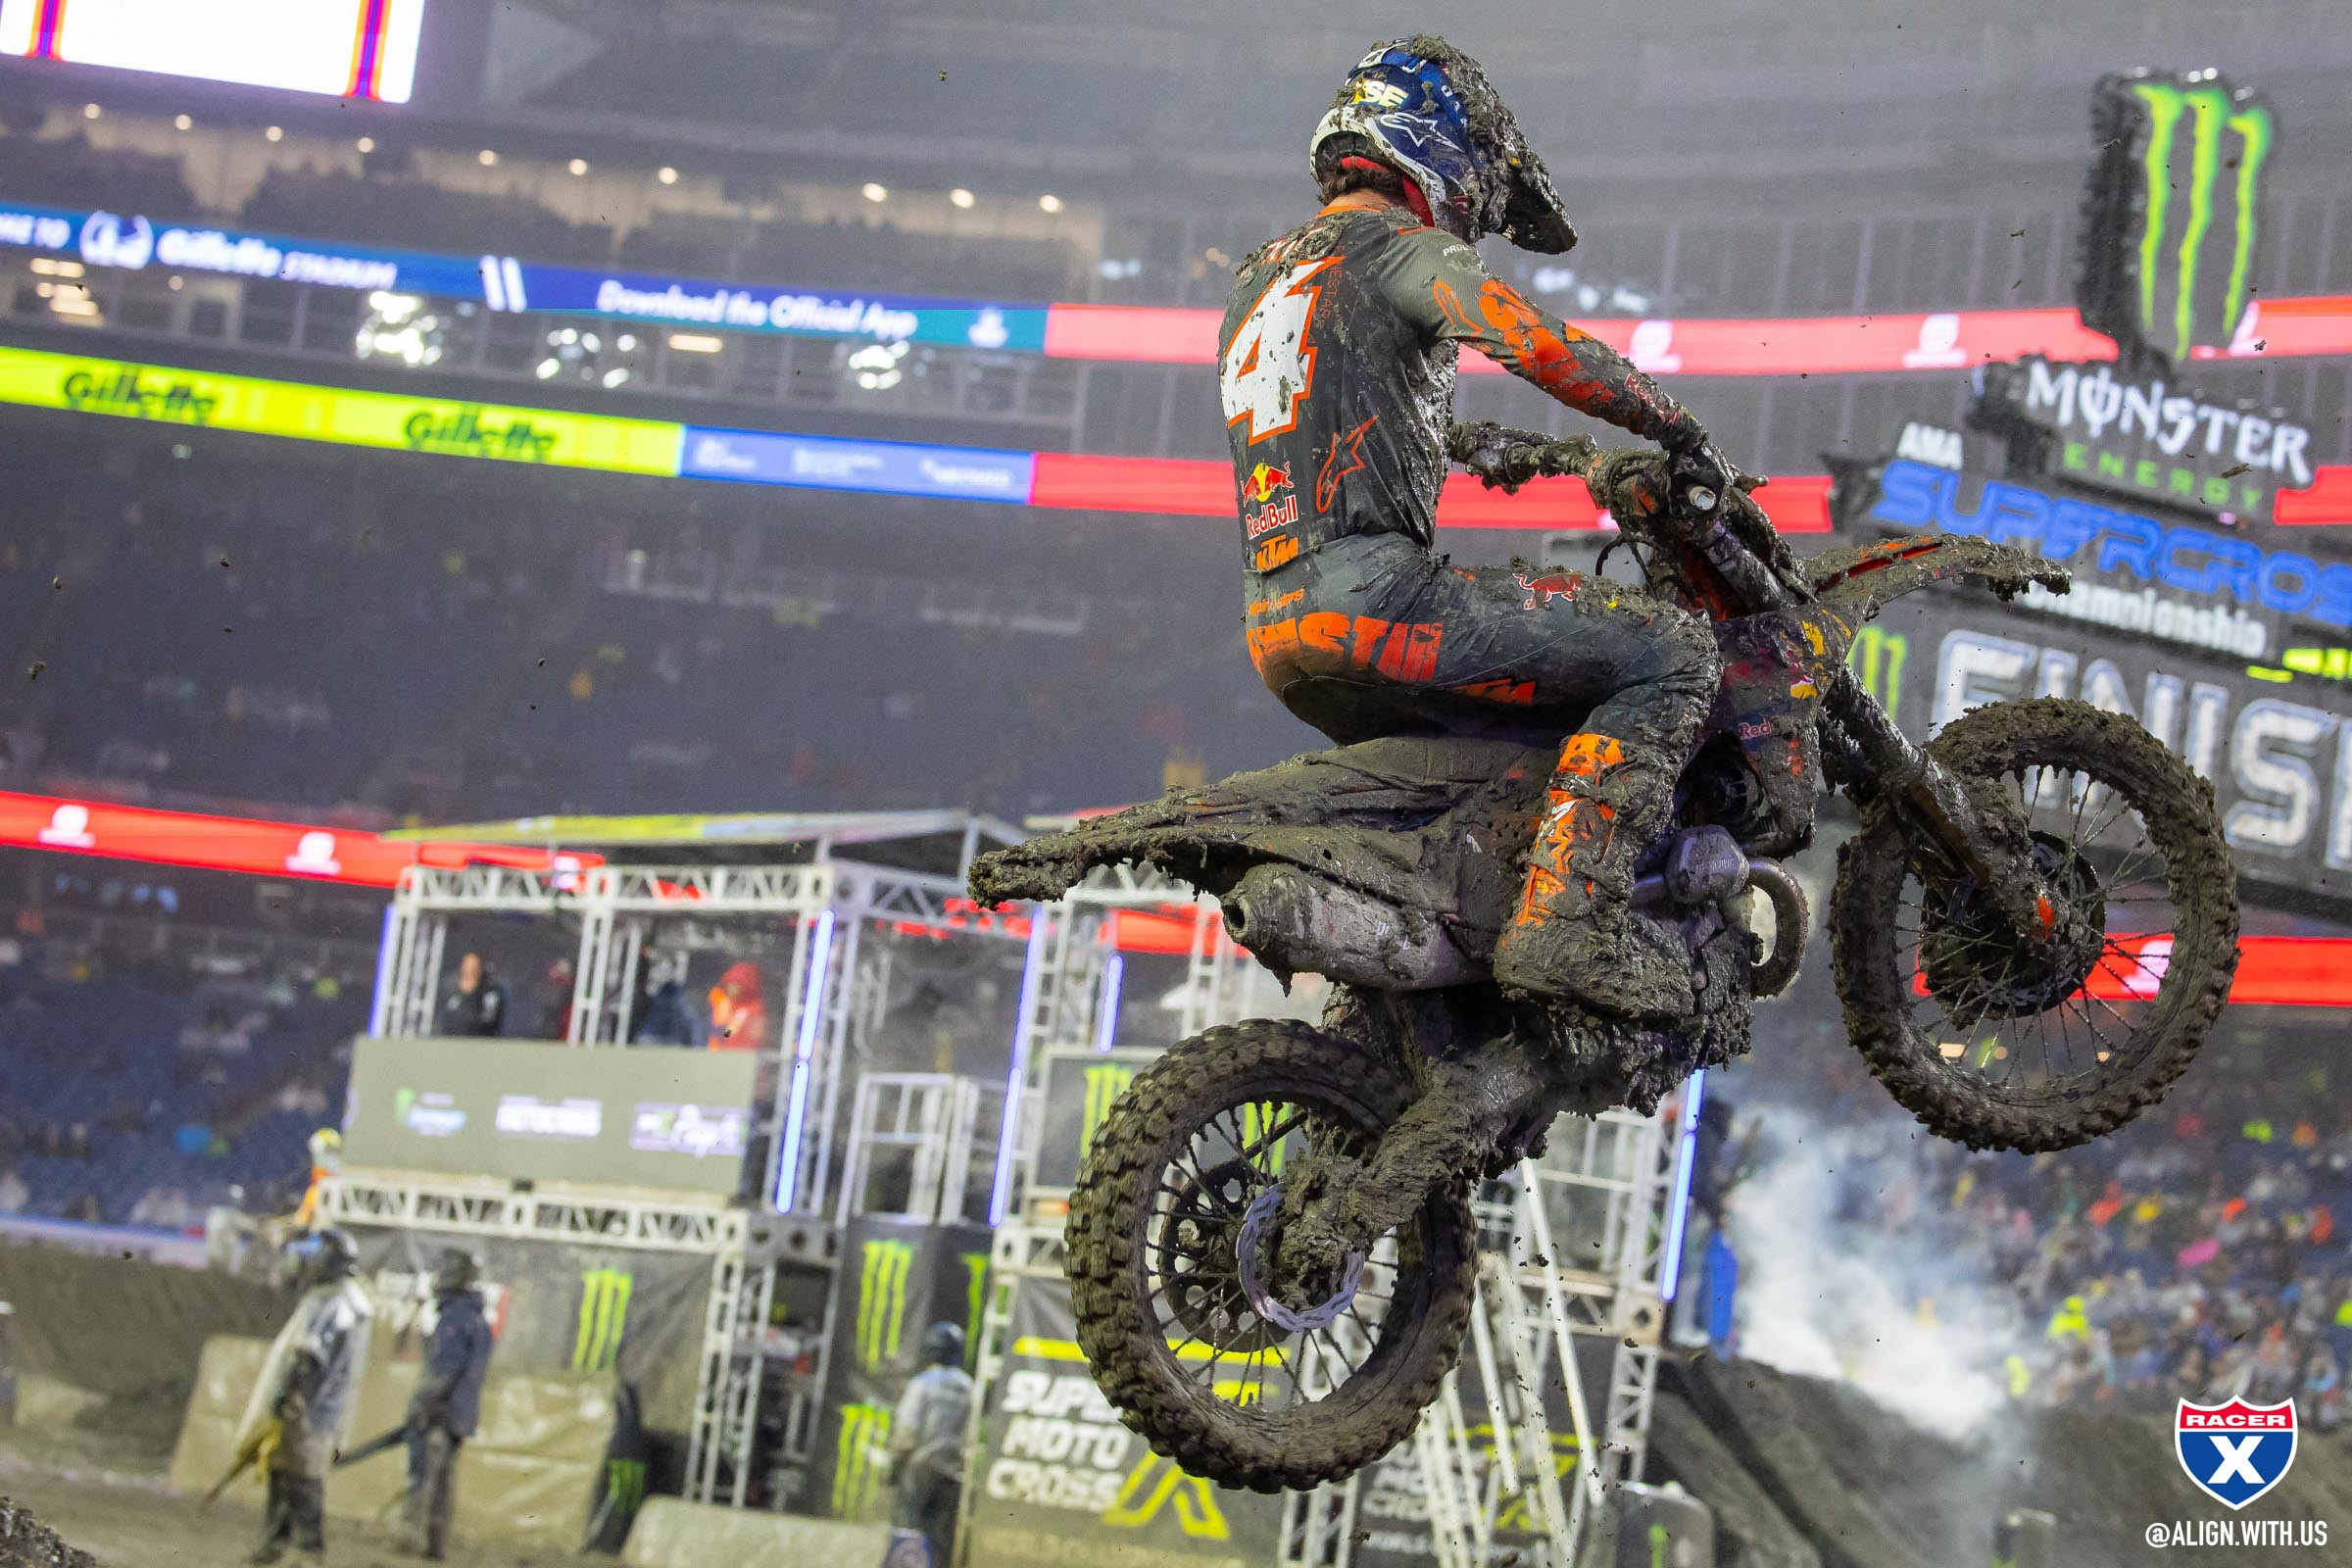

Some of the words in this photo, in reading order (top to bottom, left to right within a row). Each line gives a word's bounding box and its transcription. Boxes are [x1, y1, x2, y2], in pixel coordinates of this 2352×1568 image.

[596, 279, 729, 323] Download
[726, 290, 768, 326] the
[769, 295, 864, 332] Official
[859, 302, 918, 341] App
[1223, 256, 1347, 446] 4
[64, 370, 216, 422] Gillette
[2026, 360, 2314, 485] MONSTER
[406, 411, 557, 462] Gillette
[2064, 442, 2263, 512] ENERGY
[1245, 503, 1268, 539] Red
[1266, 495, 1298, 530] Bull
[1256, 534, 1298, 571] KTM
[1738, 717, 1772, 740] Red
[1002, 1370, 1125, 1421] SUPE
[1001, 1416, 1132, 1470] MOTO
[988, 1457, 1126, 1514] CROSS
